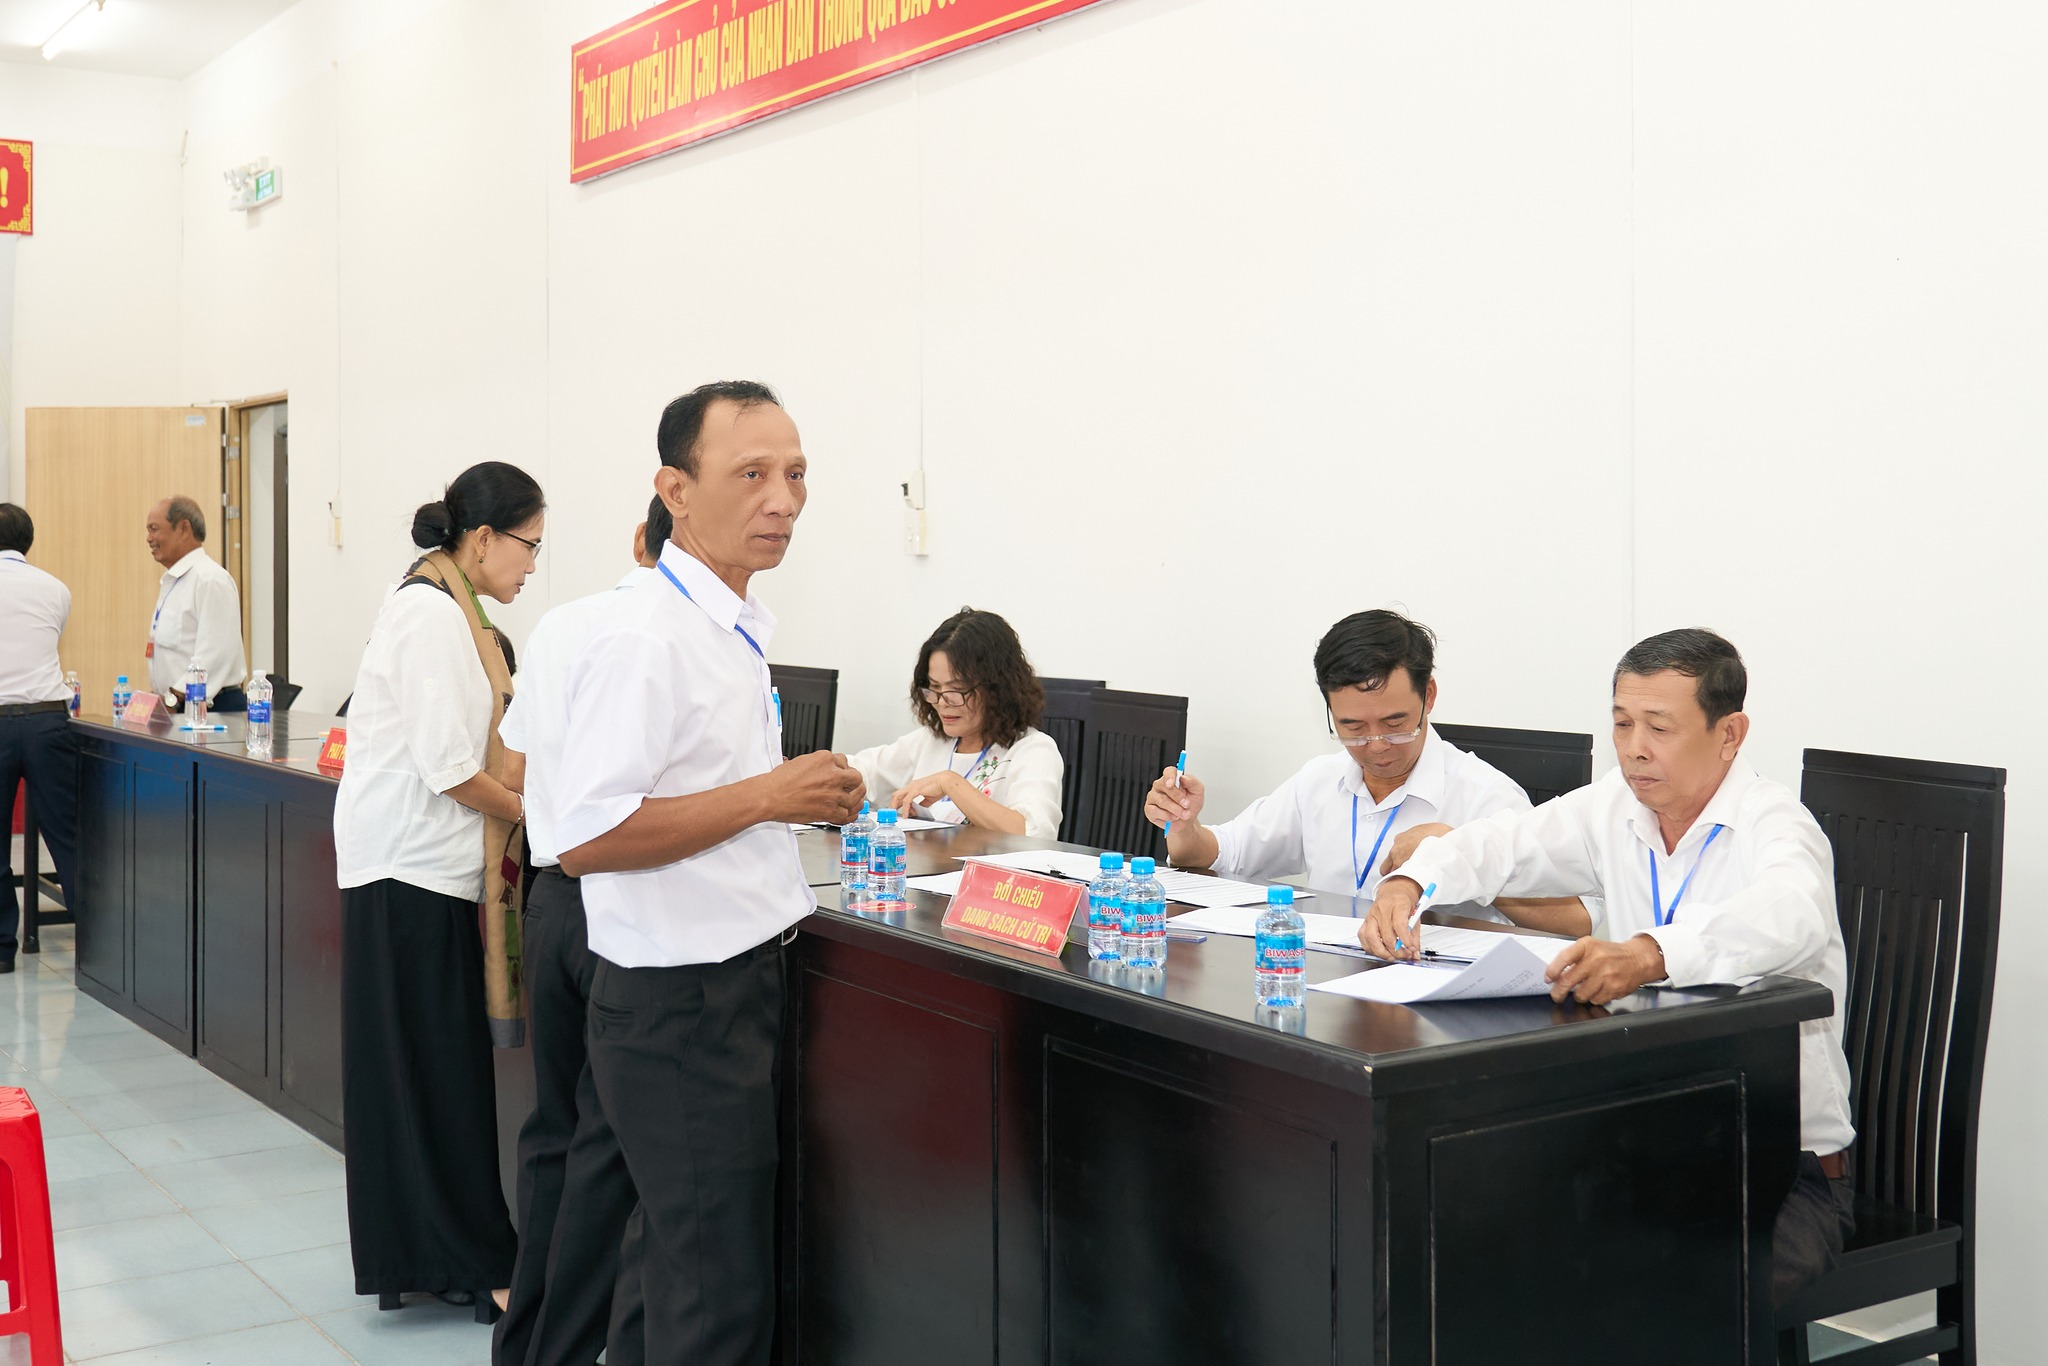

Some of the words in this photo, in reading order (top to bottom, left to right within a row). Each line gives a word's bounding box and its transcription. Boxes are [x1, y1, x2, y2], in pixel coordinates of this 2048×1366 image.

[609, 65, 630, 133] HUY
[668, 29, 693, 111] LÀM
[694, 4, 719, 101] CHỦ
[720, 0, 745, 91] CỦA
[0, 167, 8, 208] !
[1011, 885, 1044, 909] CHIẾU
[960, 906, 991, 928] DANH
[988, 911, 1019, 935] SÁCH
[1016, 916, 1037, 939] CỬ
[1032, 925, 1053, 945] TRI
